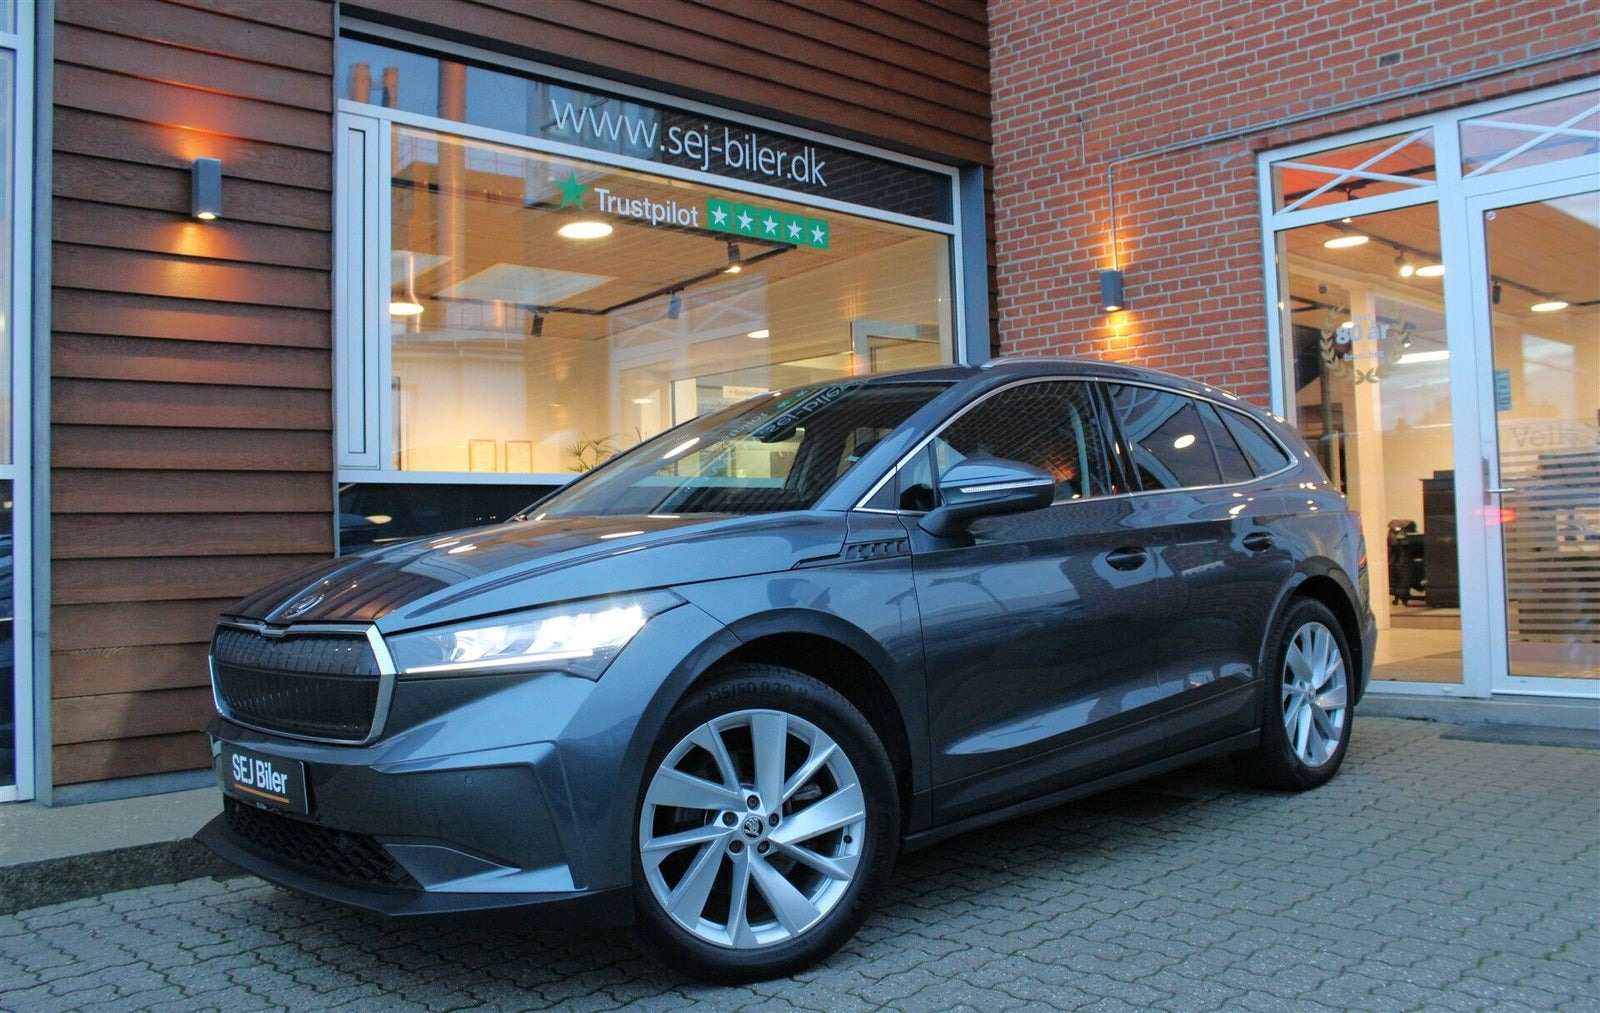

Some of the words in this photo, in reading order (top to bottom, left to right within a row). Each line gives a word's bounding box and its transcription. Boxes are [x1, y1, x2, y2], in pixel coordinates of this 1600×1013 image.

[551, 99, 827, 187] www.sej-biler.dk
[594, 187, 699, 228] Trustpilot
[1336, 323, 1362, 344] 80
[232, 753, 253, 785] SEJ
[255, 759, 287, 794] Biler
